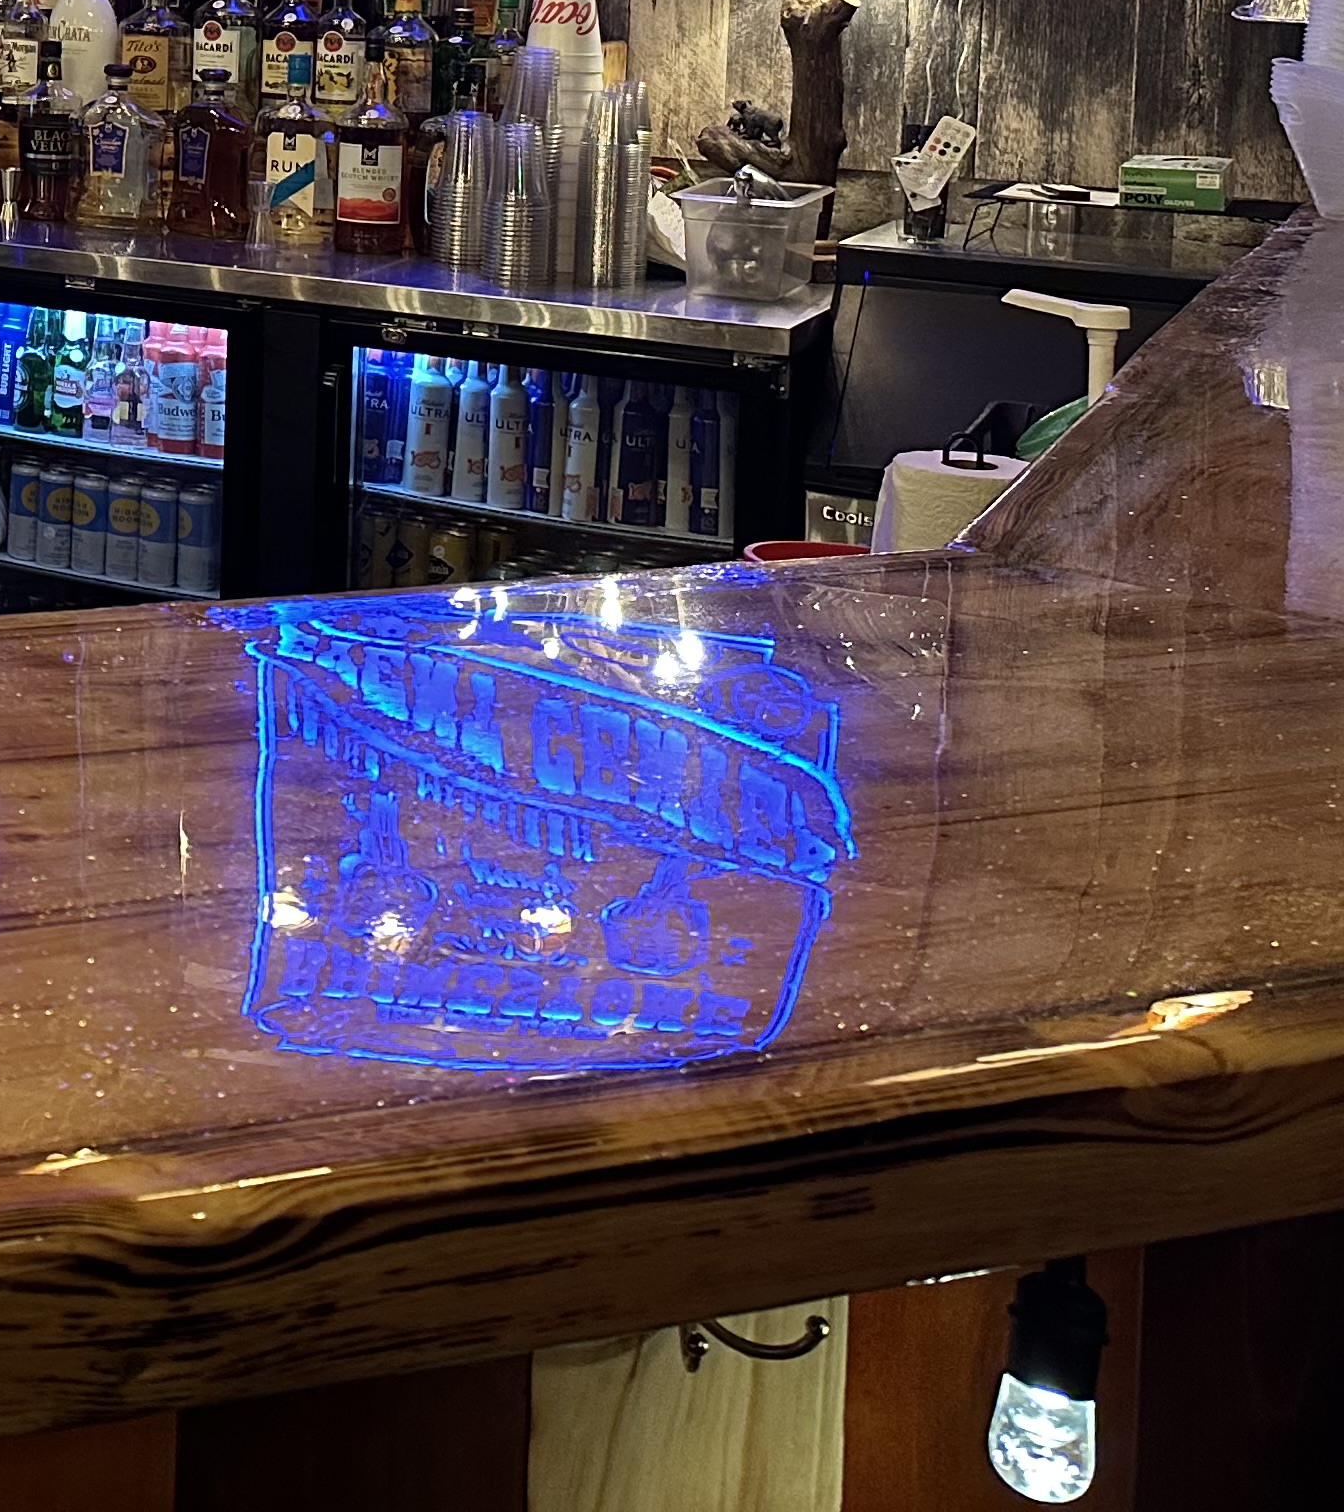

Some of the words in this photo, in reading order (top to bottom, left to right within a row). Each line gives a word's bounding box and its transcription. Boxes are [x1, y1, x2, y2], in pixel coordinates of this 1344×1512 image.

[126, 40, 161, 53] Tito's
[34, 130, 71, 141] BLAC
[31, 140, 70, 152] VELV
[270, 159, 310, 173] RUM
[1124, 193, 1164, 205] POLY
[2, 343, 12, 373] LIGHT
[0, 373, 9, 396] BUD
[412, 406, 450, 419] ULTRA
[822, 506, 873, 526] Cools
